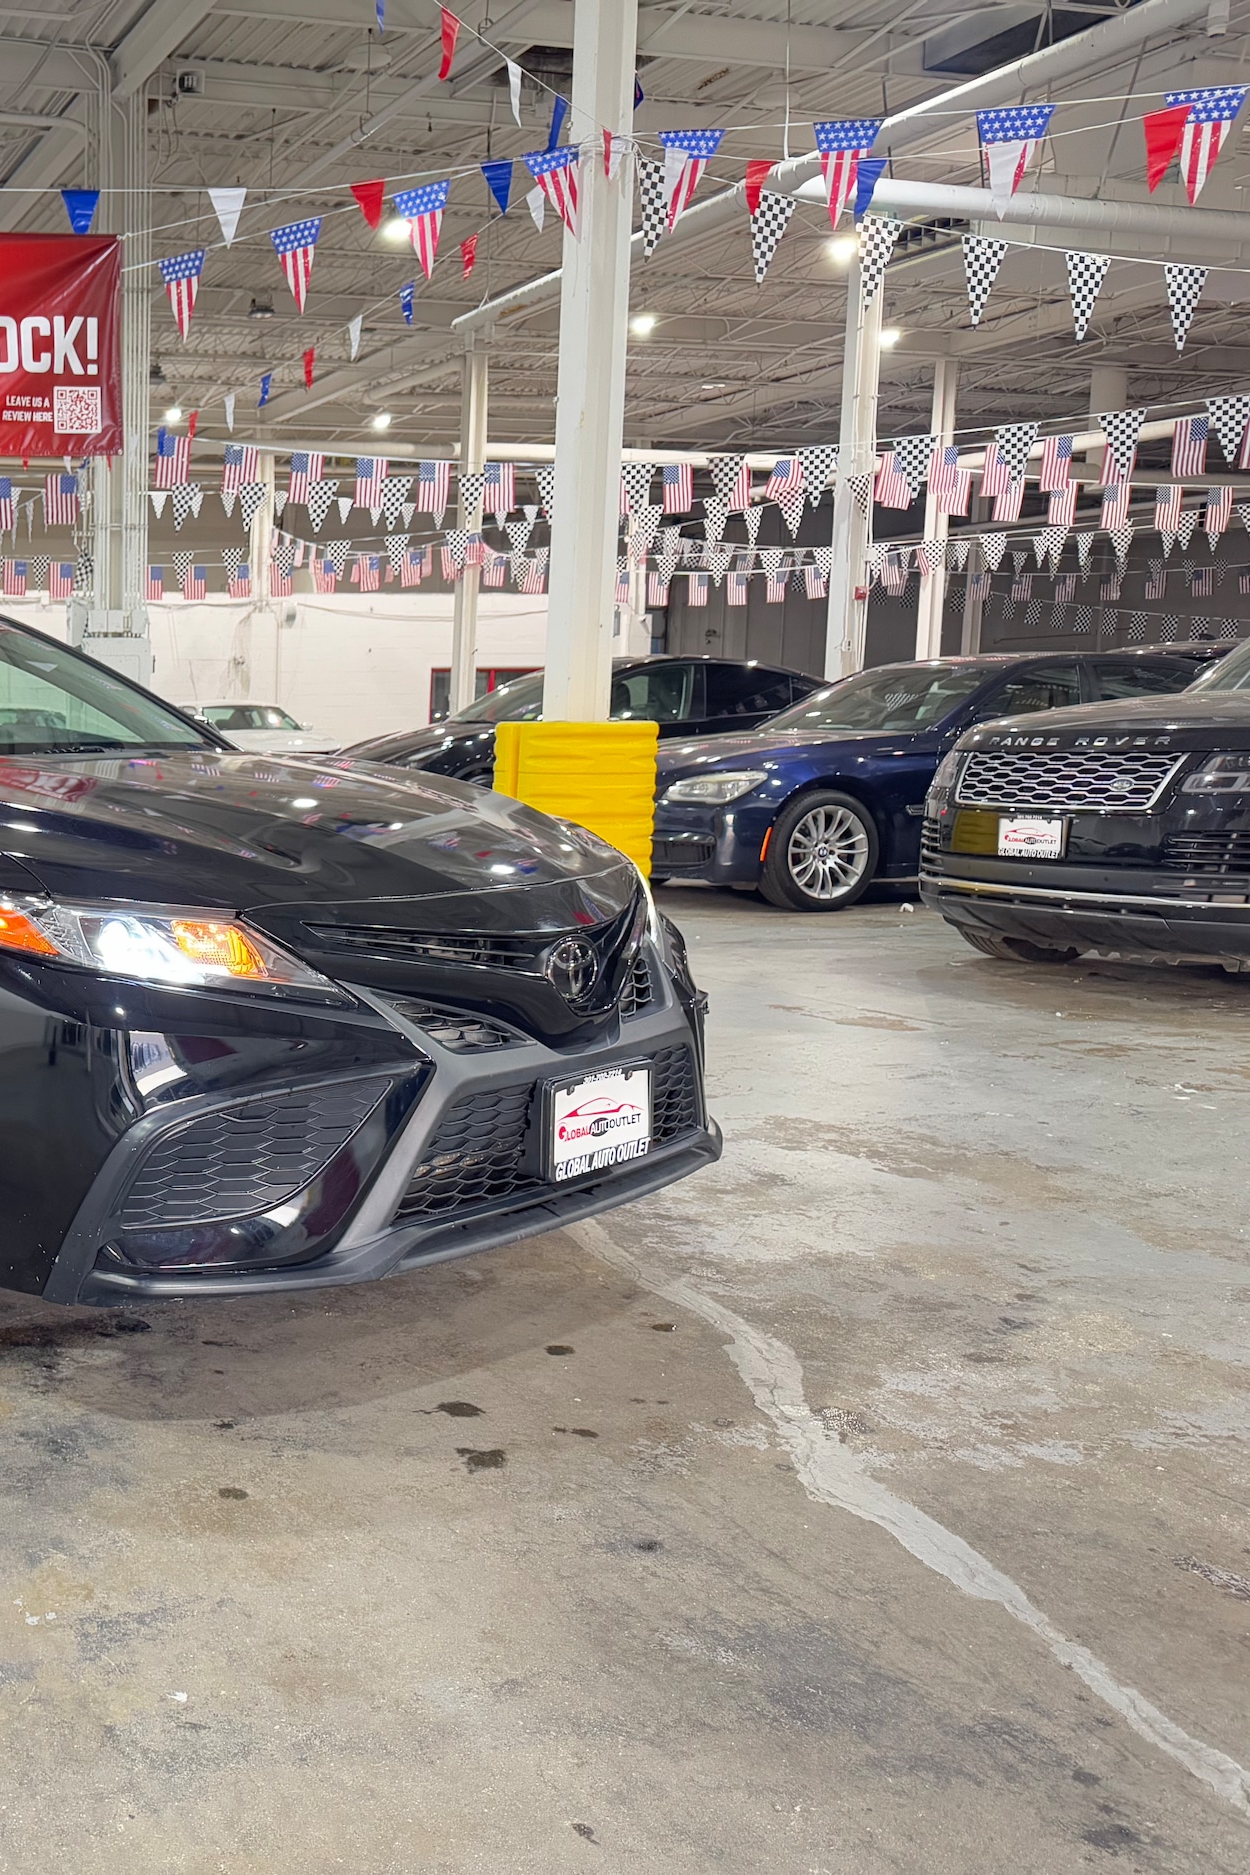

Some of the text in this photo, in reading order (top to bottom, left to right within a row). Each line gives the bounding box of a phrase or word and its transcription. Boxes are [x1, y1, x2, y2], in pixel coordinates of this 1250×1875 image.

[5, 395, 50, 408] LEAVE US A
[2, 410, 53, 422] REVIEW HERE
[989, 736, 1171, 746] RANGE ROVER
[998, 848, 1060, 859] GLOBAL AUTO OUTLET
[555, 1137, 652, 1181] GLOBAL AUTO OUTLET
